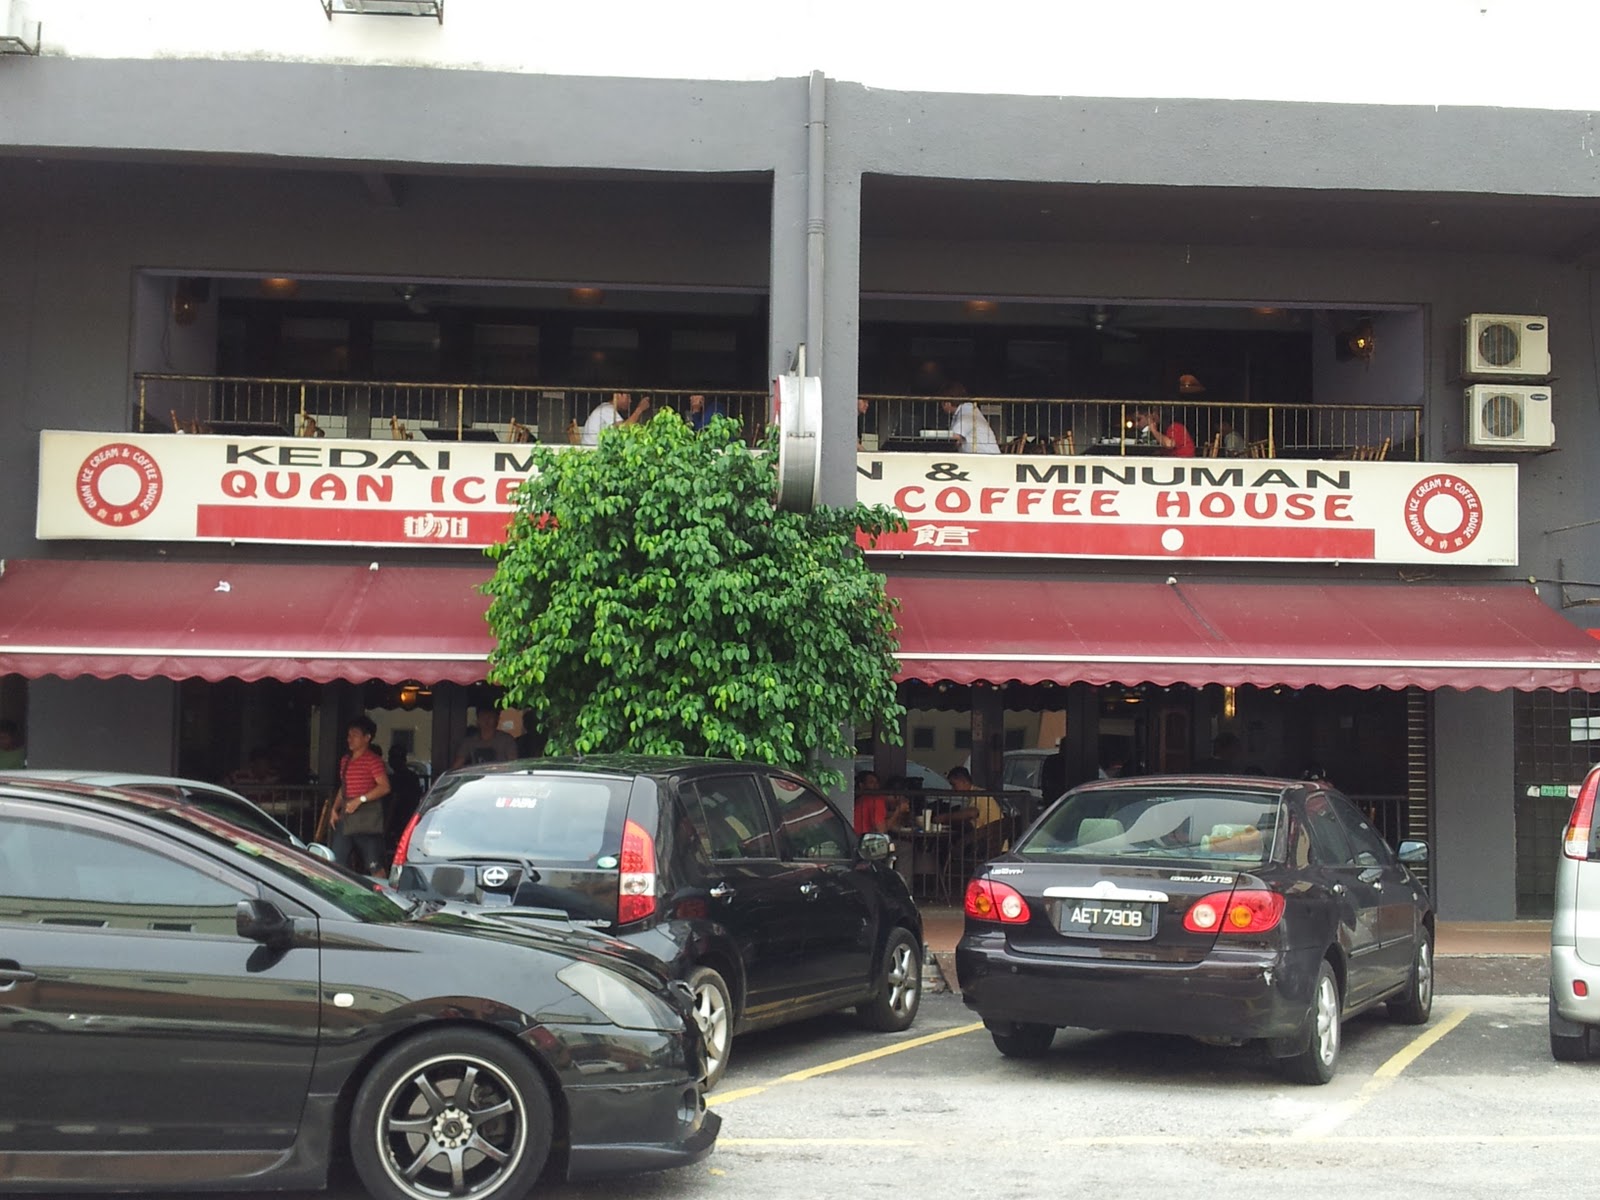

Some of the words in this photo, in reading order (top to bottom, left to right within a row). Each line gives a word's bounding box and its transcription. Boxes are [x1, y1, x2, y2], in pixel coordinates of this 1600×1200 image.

[90, 447, 119, 468] CREAM
[122, 448, 130, 458] &
[226, 444, 450, 470] KEDAI
[81, 468, 94, 482] ICE
[133, 452, 157, 480] COFFEE
[925, 462, 972, 482] &
[1016, 464, 1350, 489] MINUMAN
[221, 470, 393, 502] QUAN
[431, 476, 526, 505] ICE
[1415, 478, 1442, 497] CREAM
[1444, 478, 1452, 488] &
[81, 484, 97, 509] QUAN
[139, 482, 158, 511] HOUSE
[894, 486, 1120, 516] COFFEE
[1156, 491, 1354, 521] HOUSE
[1409, 497, 1420, 512] ICE
[1454, 482, 1478, 510] COFFEE
[1409, 513, 1424, 537] QUAN
[1463, 511, 1479, 539] HOUSE
[1198, 875, 1233, 885] ALTIS
[1070, 907, 1101, 924] AET
[1103, 908, 1142, 927] 7908
